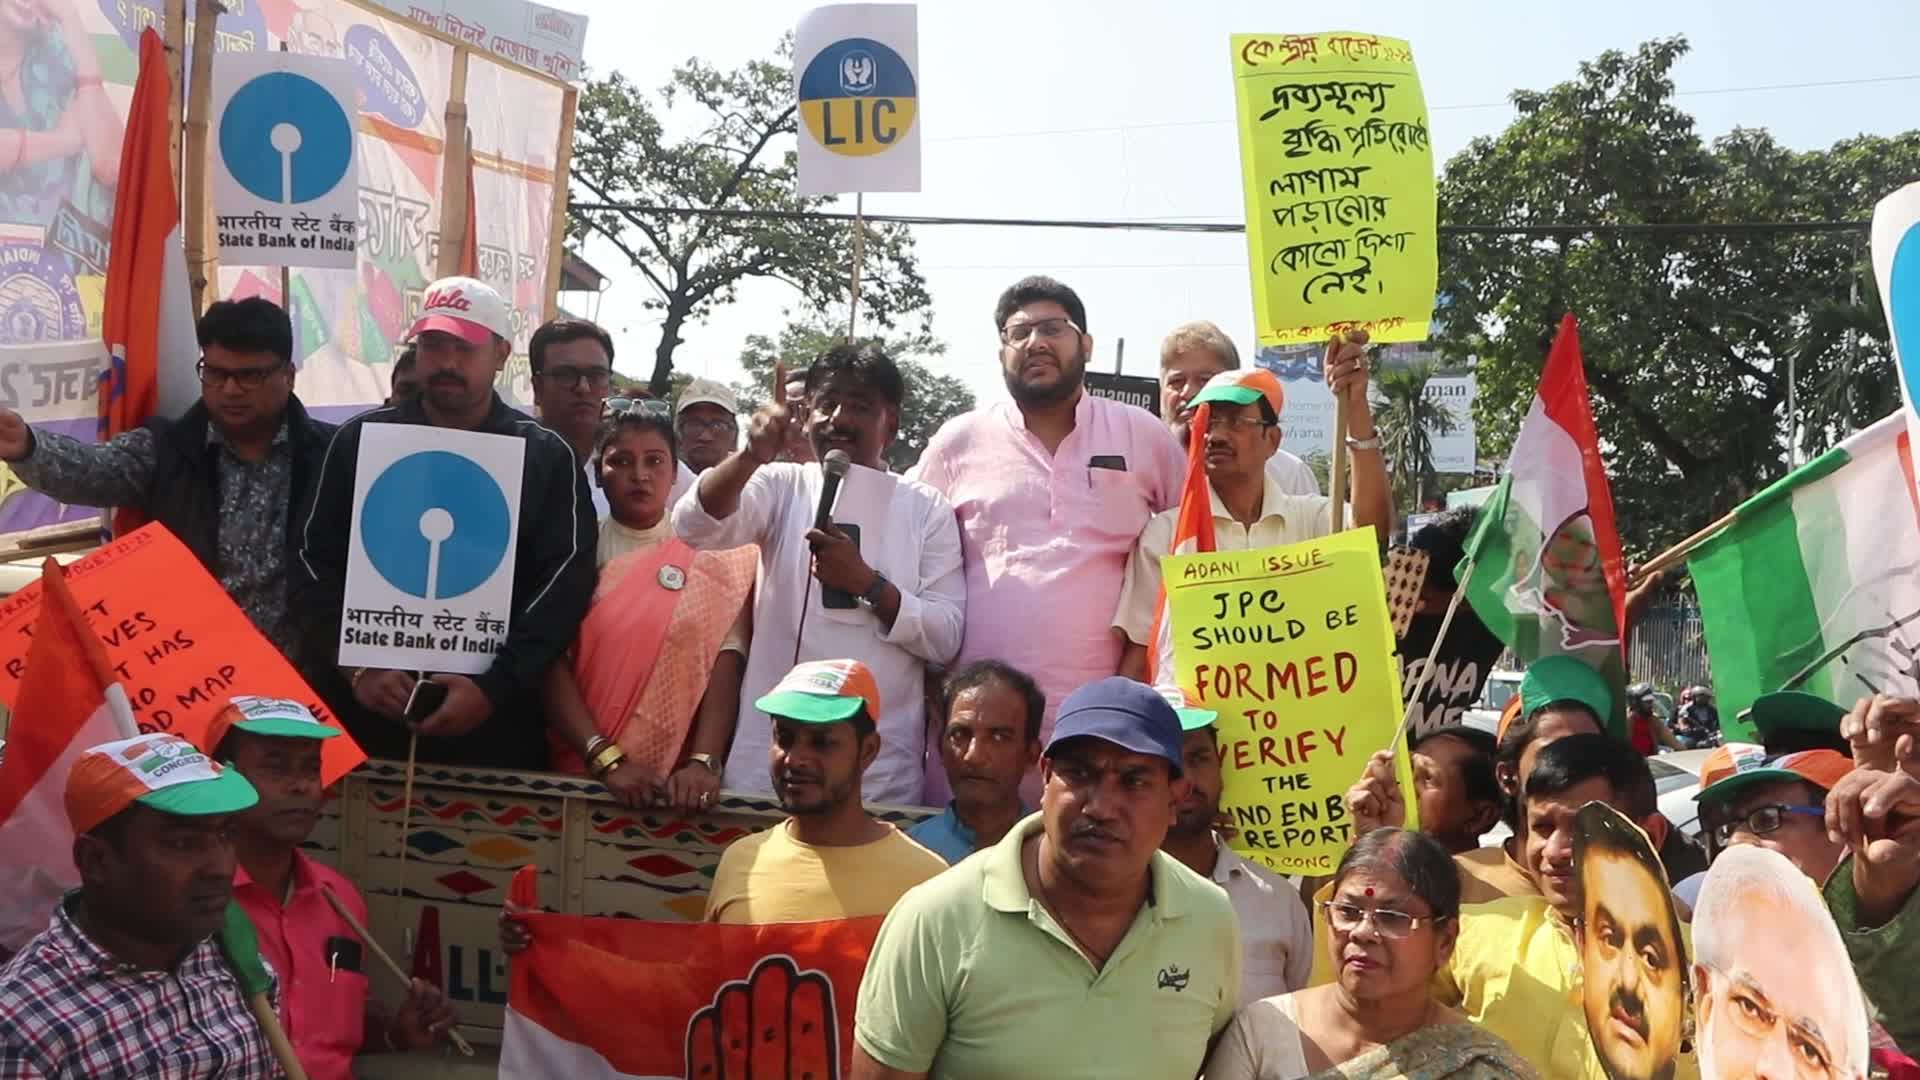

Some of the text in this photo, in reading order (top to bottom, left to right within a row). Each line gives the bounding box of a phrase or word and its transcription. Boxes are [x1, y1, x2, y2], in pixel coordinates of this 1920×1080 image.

[1259, 82, 1395, 121] দ্রব্যমূল্য
[823, 99, 897, 145] LIC
[1282, 119, 1341, 158] বৃদ্ধি
[217, 210, 282, 230] भारतीय
[290, 211, 321, 232] स्टेट
[219, 232, 355, 252] State Bank of India
[1425, 383, 1467, 397] man
[1183, 548, 1326, 580] ADANI ISSUE
[347, 605, 424, 628] भारतीय
[432, 609, 467, 632] स्टेट
[1213, 588, 1286, 620] JPC
[344, 628, 505, 655] State Bank of India
[1192, 604, 1360, 650] SHOULD BE
[144, 629, 194, 665] HAS
[176, 665, 236, 710] MAP
[1195, 651, 1358, 702] FORMED
[1243, 709, 1278, 732] TO
[1262, 773, 1312, 794] THE
[1244, 823, 1352, 849] REPORT
